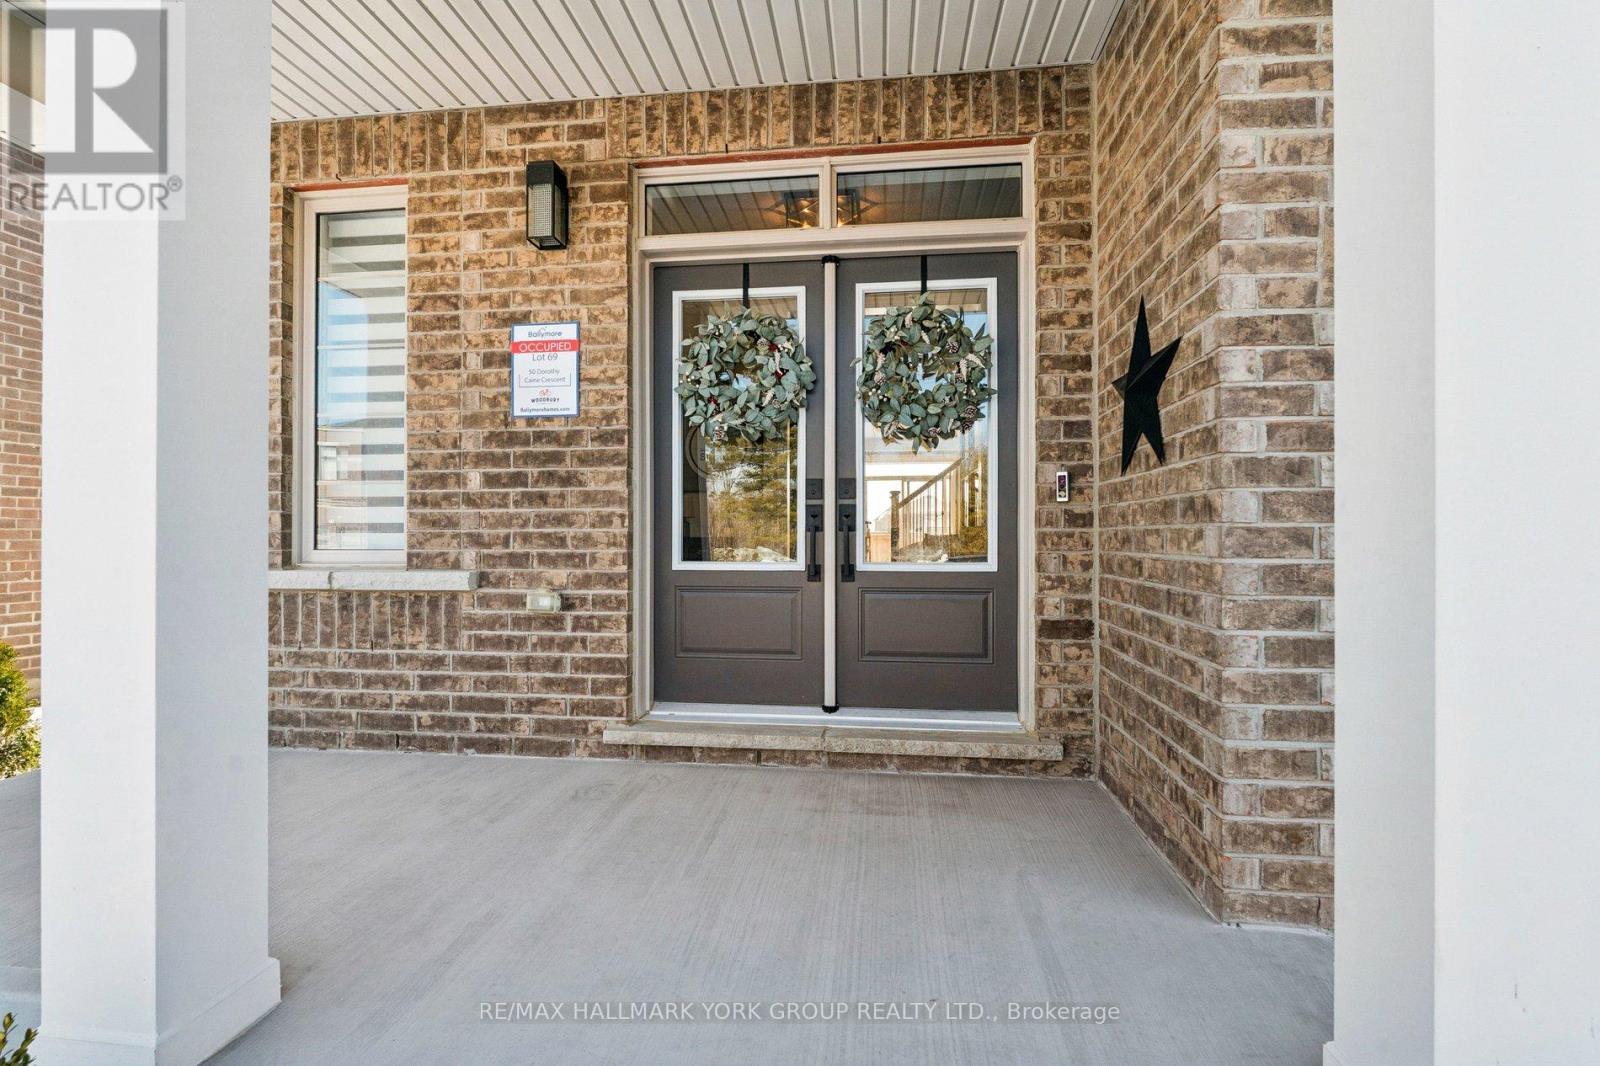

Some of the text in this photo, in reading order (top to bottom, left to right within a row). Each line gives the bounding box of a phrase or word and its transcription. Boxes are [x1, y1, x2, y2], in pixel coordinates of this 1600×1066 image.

[527, 330, 563, 338] Ballymore
[518, 342, 572, 353] OCCUPIED
[532, 352, 559, 362] Lot 69
